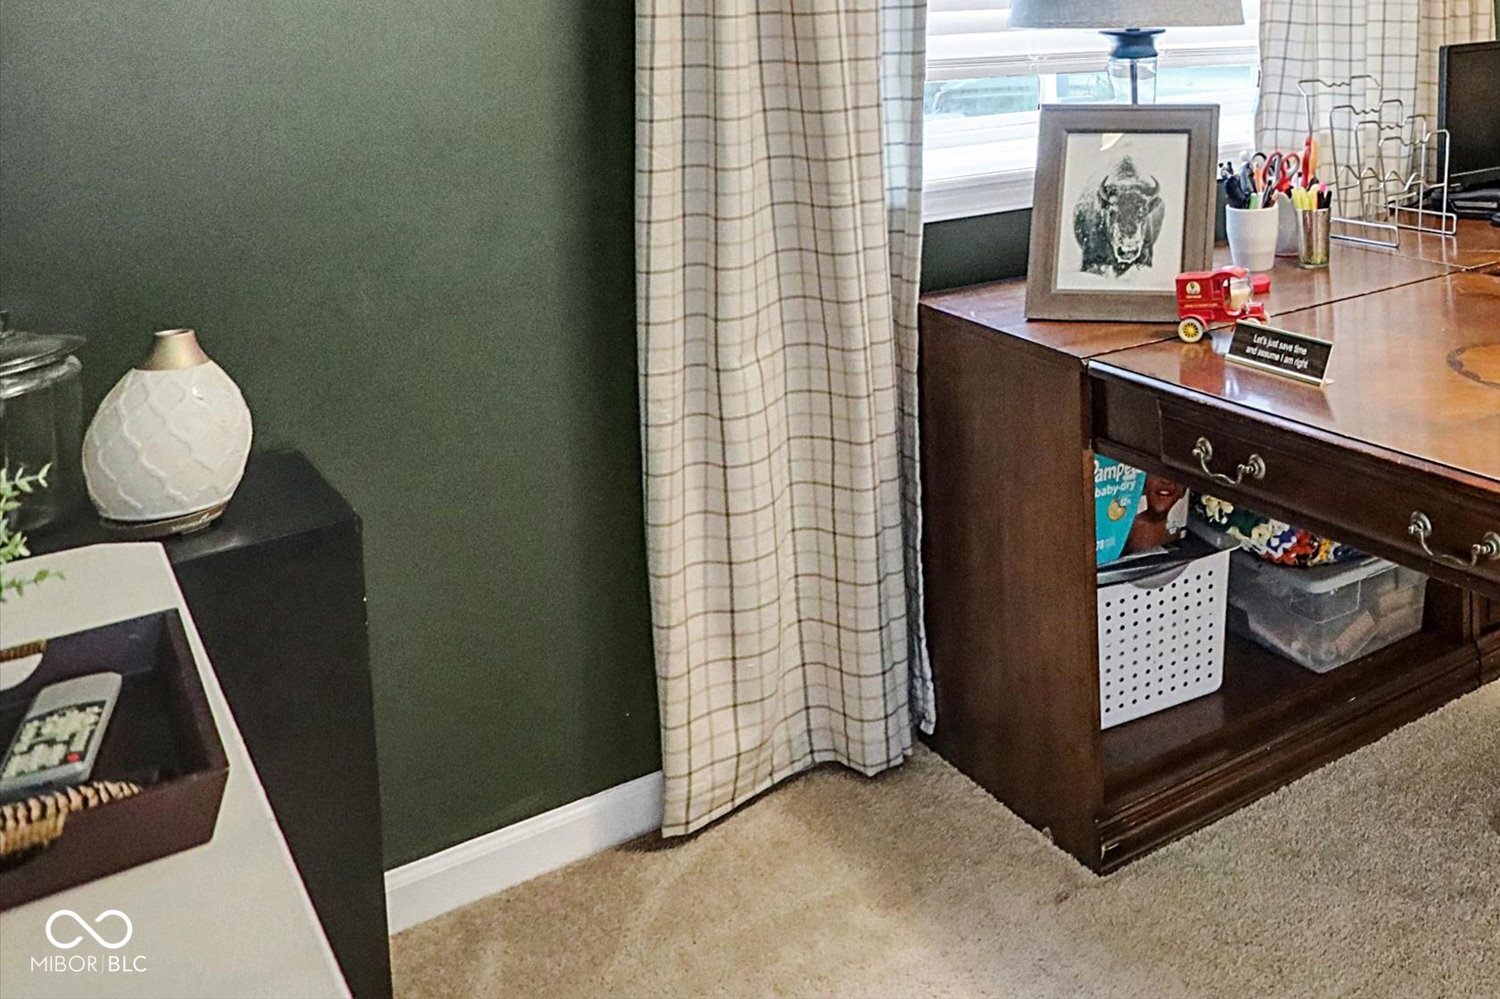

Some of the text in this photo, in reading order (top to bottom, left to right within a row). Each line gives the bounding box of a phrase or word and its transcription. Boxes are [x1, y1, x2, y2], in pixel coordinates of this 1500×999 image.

[1253, 334, 1308, 356] Let's just save time
[1245, 346, 1258, 355] and
[1257, 349, 1280, 361] assume
[1284, 355, 1294, 365] am
[1294, 358, 1308, 369] right
